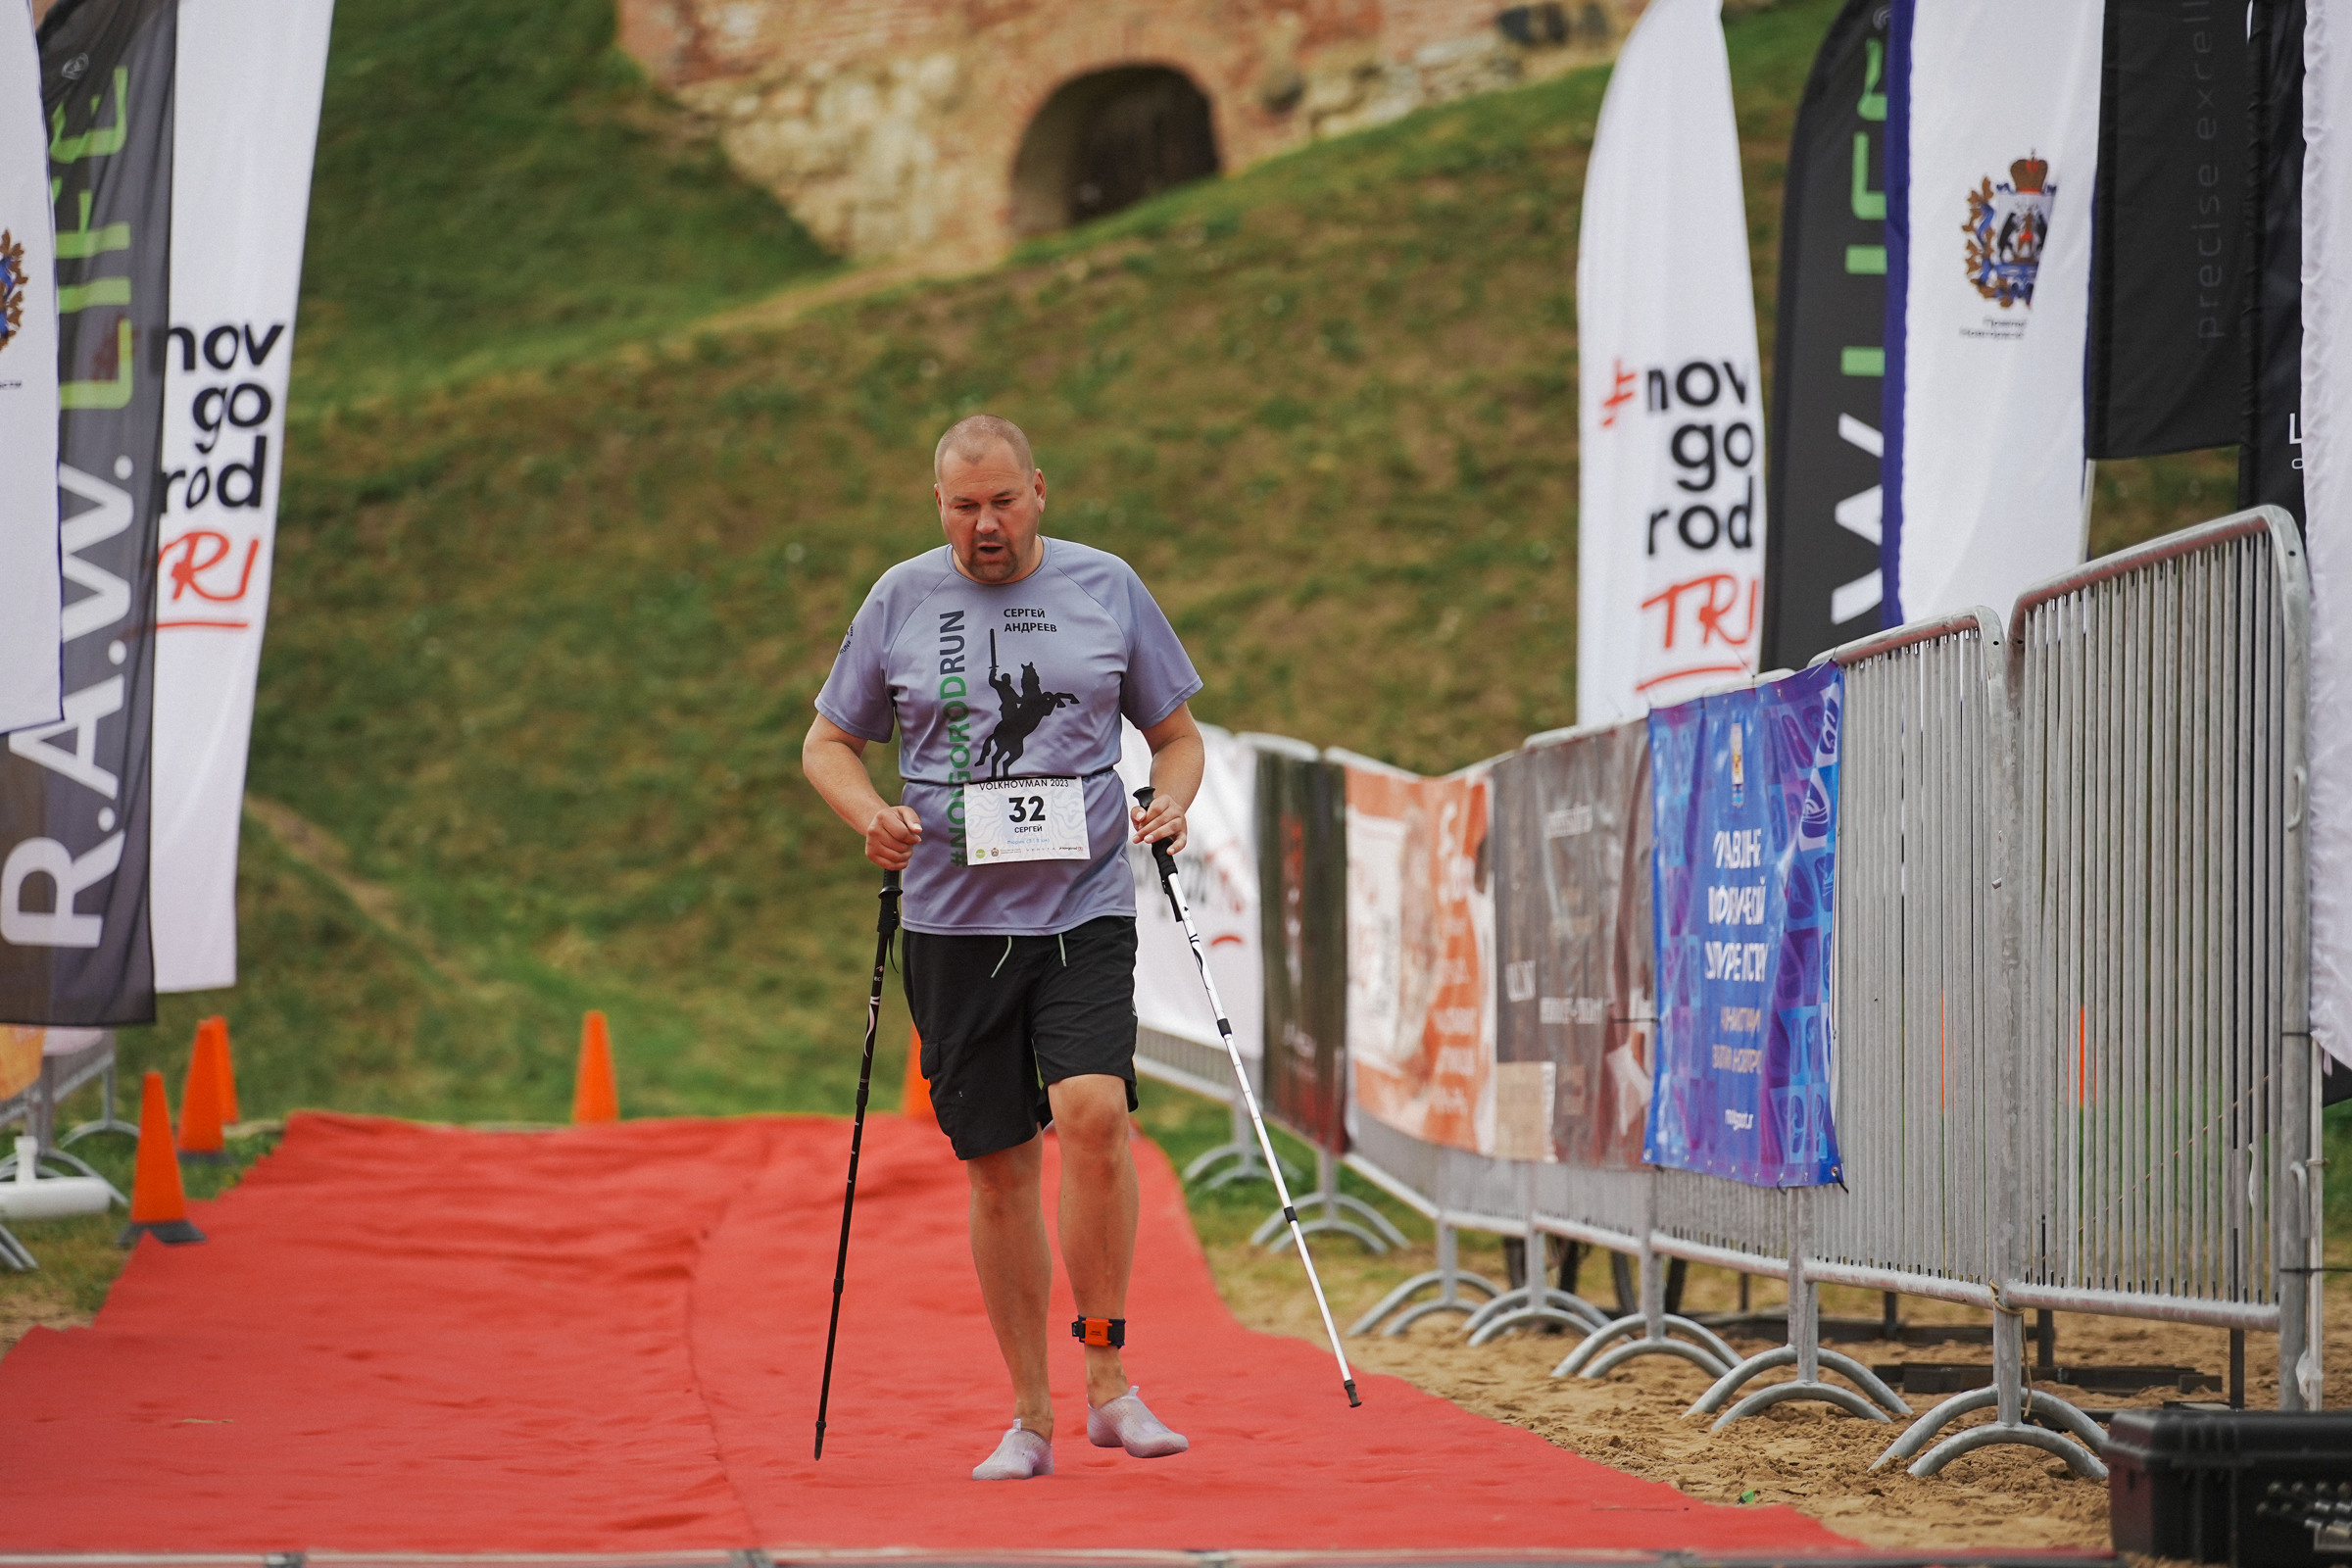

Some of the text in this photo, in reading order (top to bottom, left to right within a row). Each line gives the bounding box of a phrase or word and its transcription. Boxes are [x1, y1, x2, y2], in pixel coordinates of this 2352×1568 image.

[2190, 164, 2226, 339] precise
[192, 382, 271, 454] go
[158, 434, 268, 514] rod
[1671, 420, 1754, 493] go
[1647, 474, 1753, 557] rod
[1004, 608, 1046, 618] СЕРГЕЙ
[1004, 622, 1057, 633] АНДРЕЕВ
[1640, 573, 1757, 650] TRI
[979, 779, 1048, 791] VOLKHOVMAN
[1008, 796, 1046, 822] 32
[1014, 824, 1043, 833] СЕРГЕЙ
